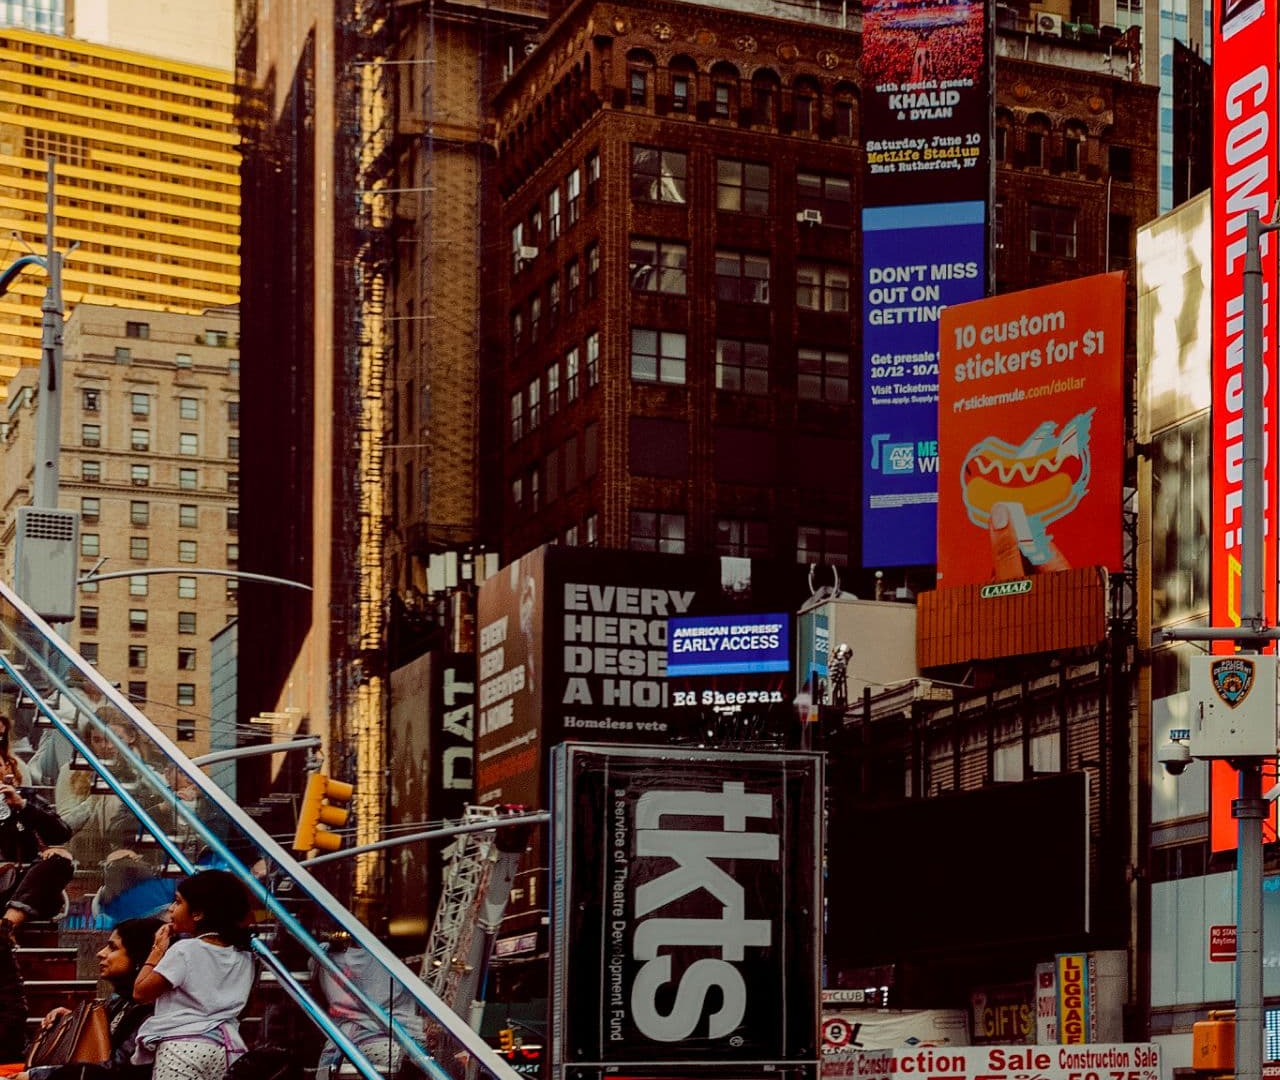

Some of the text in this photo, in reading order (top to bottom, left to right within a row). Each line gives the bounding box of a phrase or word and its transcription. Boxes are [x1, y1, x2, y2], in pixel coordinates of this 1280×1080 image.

[876, 84, 898, 93] with
[941, 78, 973, 89] guests
[889, 91, 960, 110] KHALID
[910, 107, 953, 120] DYLAN
[866, 134, 981, 153] Saturday, June 10
[867, 147, 980, 164] MetLife Stadium
[871, 163, 896, 174] East
[898, 159, 962, 173] Rutherford,
[1225, 64, 1269, 277] COME
[869, 262, 978, 285] DON'T MISS
[869, 285, 940, 305] OUT ON
[954, 310, 1065, 350] 10 custom
[871, 351, 934, 366] Get presale
[954, 330, 1105, 383] stickers for $1
[871, 366, 904, 379] 10/12
[871, 385, 892, 395] Visit
[964, 377, 1086, 412] stickermule.com/dollar
[984, 581, 1027, 597] LAMAR
[564, 583, 696, 616] EVERY
[674, 624, 779, 637] AMERICAN EXPRESS
[673, 634, 779, 653] EARLY ACCESS
[673, 689, 783, 707] Ed Sheeran
[564, 716, 633, 732] Homeless
[608, 801, 628, 1041] service of Theatre Development Fund
[631, 781, 780, 1043] tkts
[1212, 937, 1236, 945] Anytime
[1064, 957, 1083, 1046] LUGGAGE
[983, 1004, 1034, 1038] GIFTS
[988, 1049, 1051, 1071] Sale
[1058, 1047, 1158, 1070] Construction Sale
